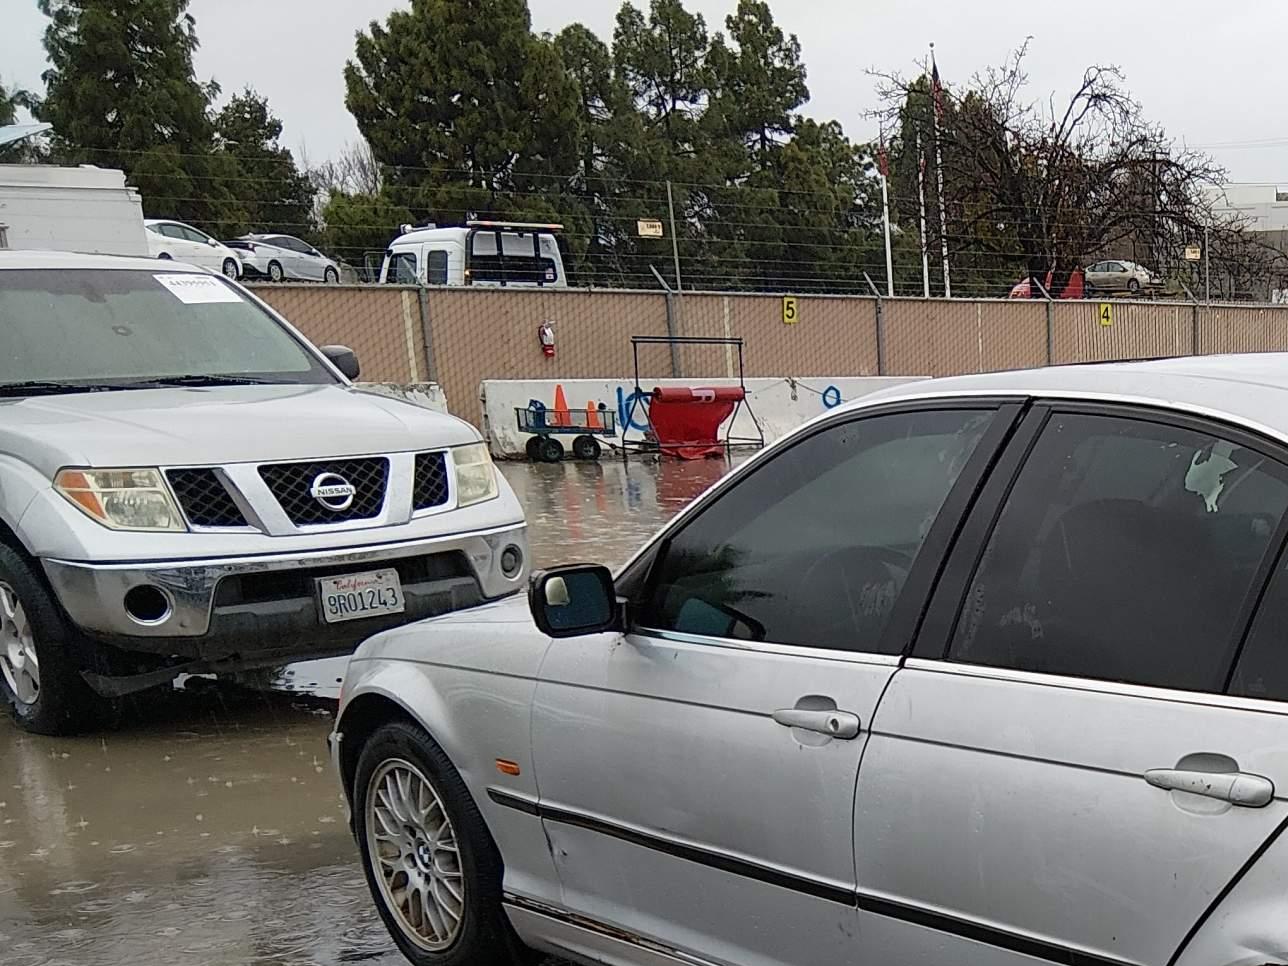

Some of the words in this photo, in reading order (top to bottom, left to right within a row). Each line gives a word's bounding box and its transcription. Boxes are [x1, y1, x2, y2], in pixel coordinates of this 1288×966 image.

[786, 301, 795, 319] 5
[1101, 306, 1110, 322] 4
[316, 485, 353, 497] NISSAN
[327, 587, 399, 616] 9R01243
